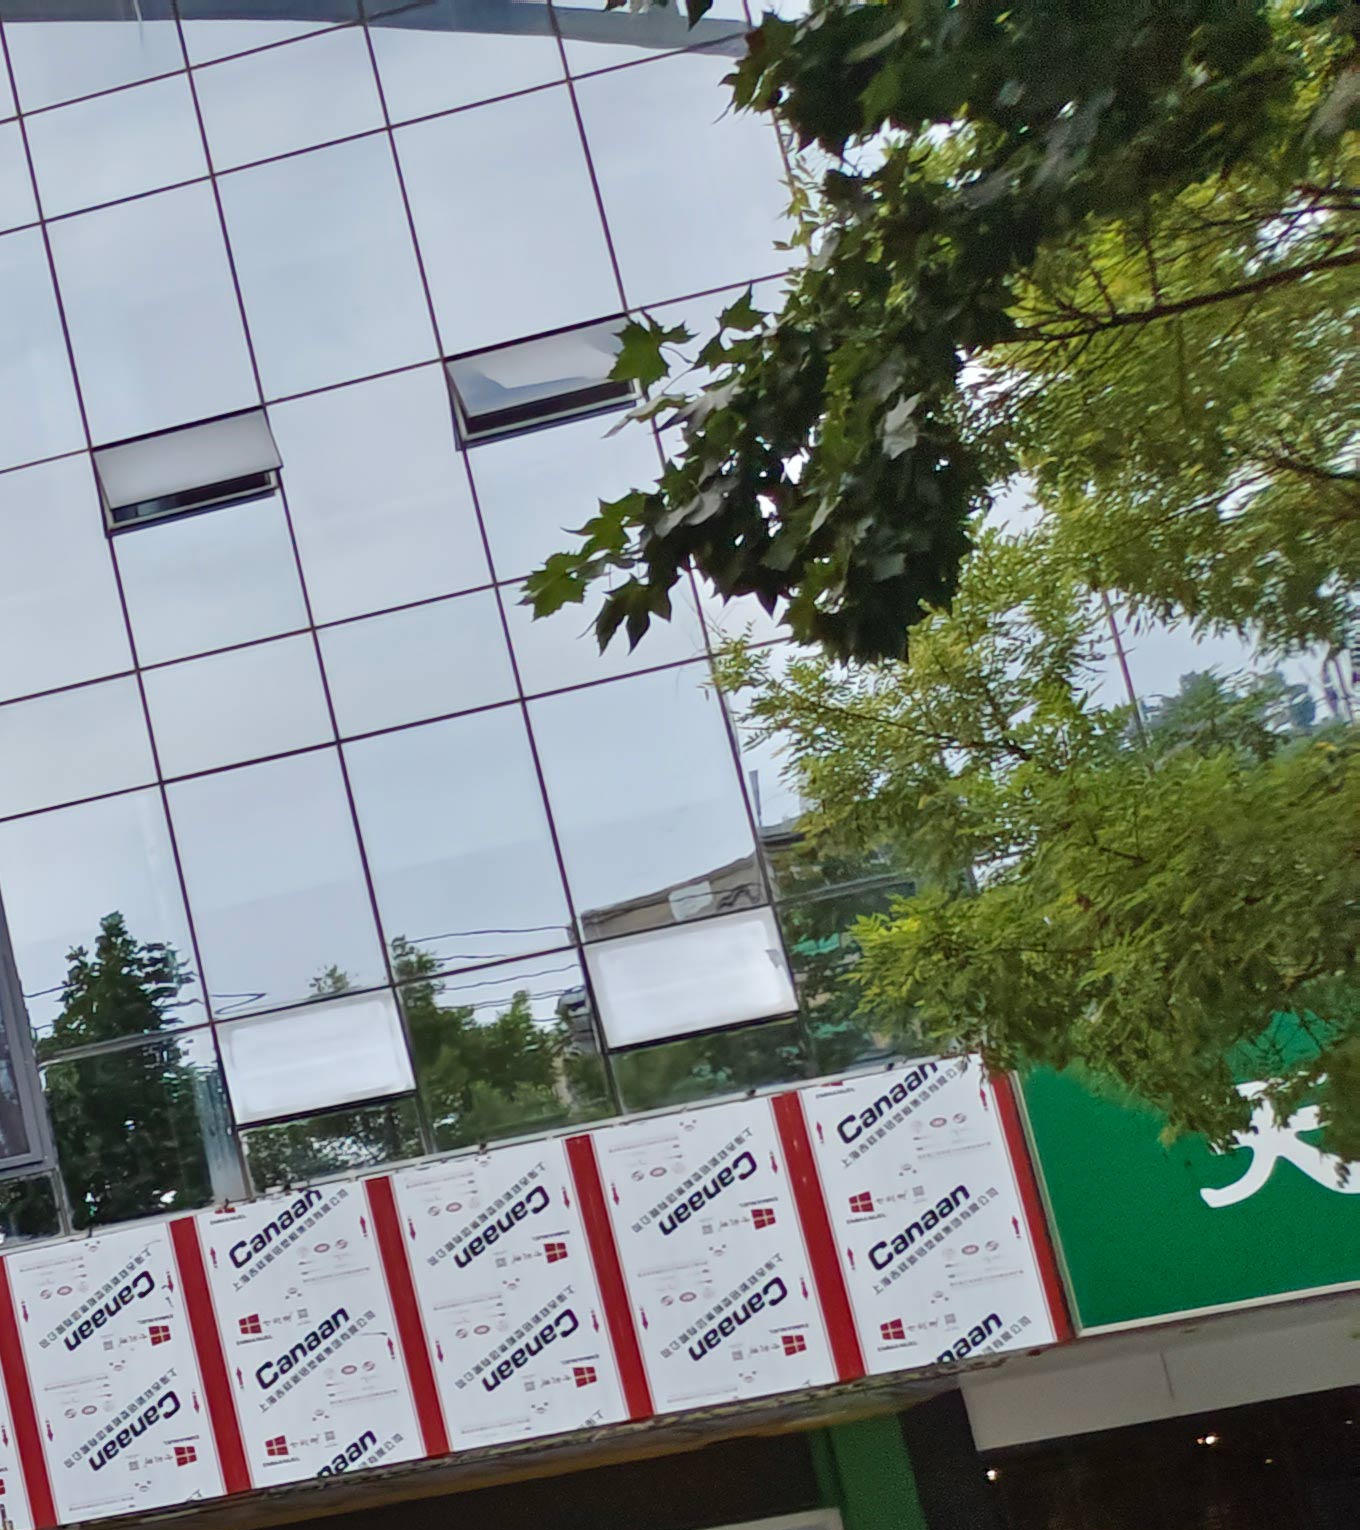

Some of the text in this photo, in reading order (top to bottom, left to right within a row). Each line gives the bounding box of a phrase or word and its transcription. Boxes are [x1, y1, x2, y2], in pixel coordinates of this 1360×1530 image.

[836, 1062, 939, 1144] Canaan
[229, 1189, 322, 1268] Canaan
[453, 1186, 550, 1268] Canaan
[658, 1151, 758, 1236] Canaan
[868, 1184, 971, 1271] Canaan
[63, 1270, 155, 1351] Canaan
[255, 1308, 350, 1390] Canaan
[482, 1308, 579, 1392] Canaan
[688, 1277, 788, 1362] Canaan
[89, 1390, 181, 1471] Canaan
